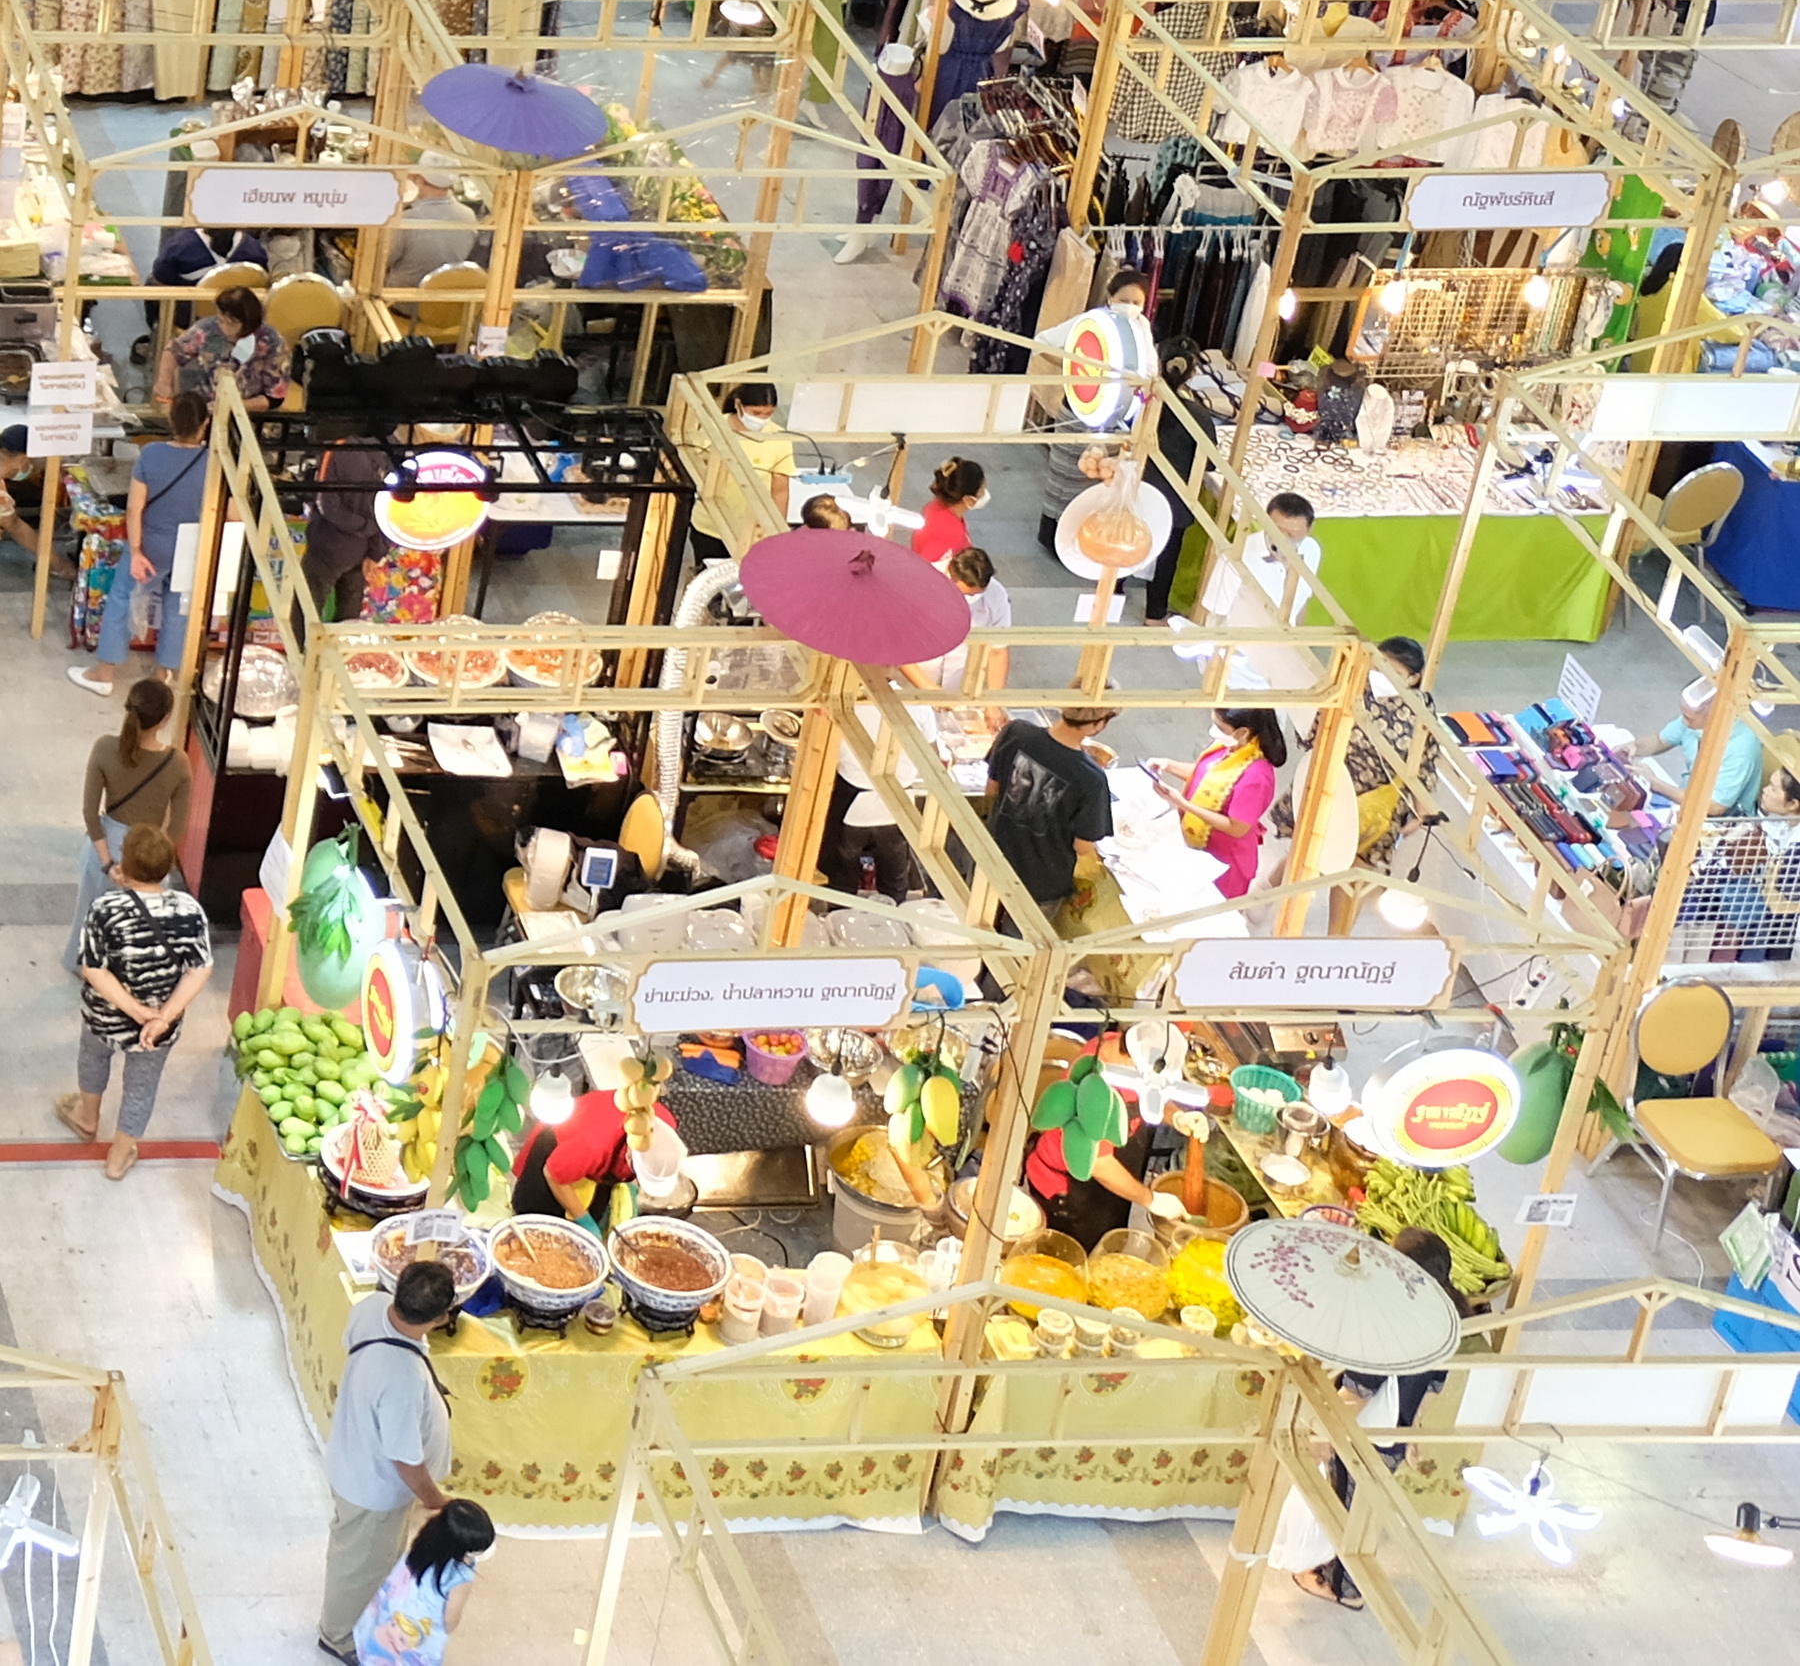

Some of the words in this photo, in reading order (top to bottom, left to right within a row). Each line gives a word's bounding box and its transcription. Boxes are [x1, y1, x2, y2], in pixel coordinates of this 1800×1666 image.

[1228, 959, 1287, 983] ส้มตำ
[721, 984, 815, 1002] น้ำปลาหวาน
